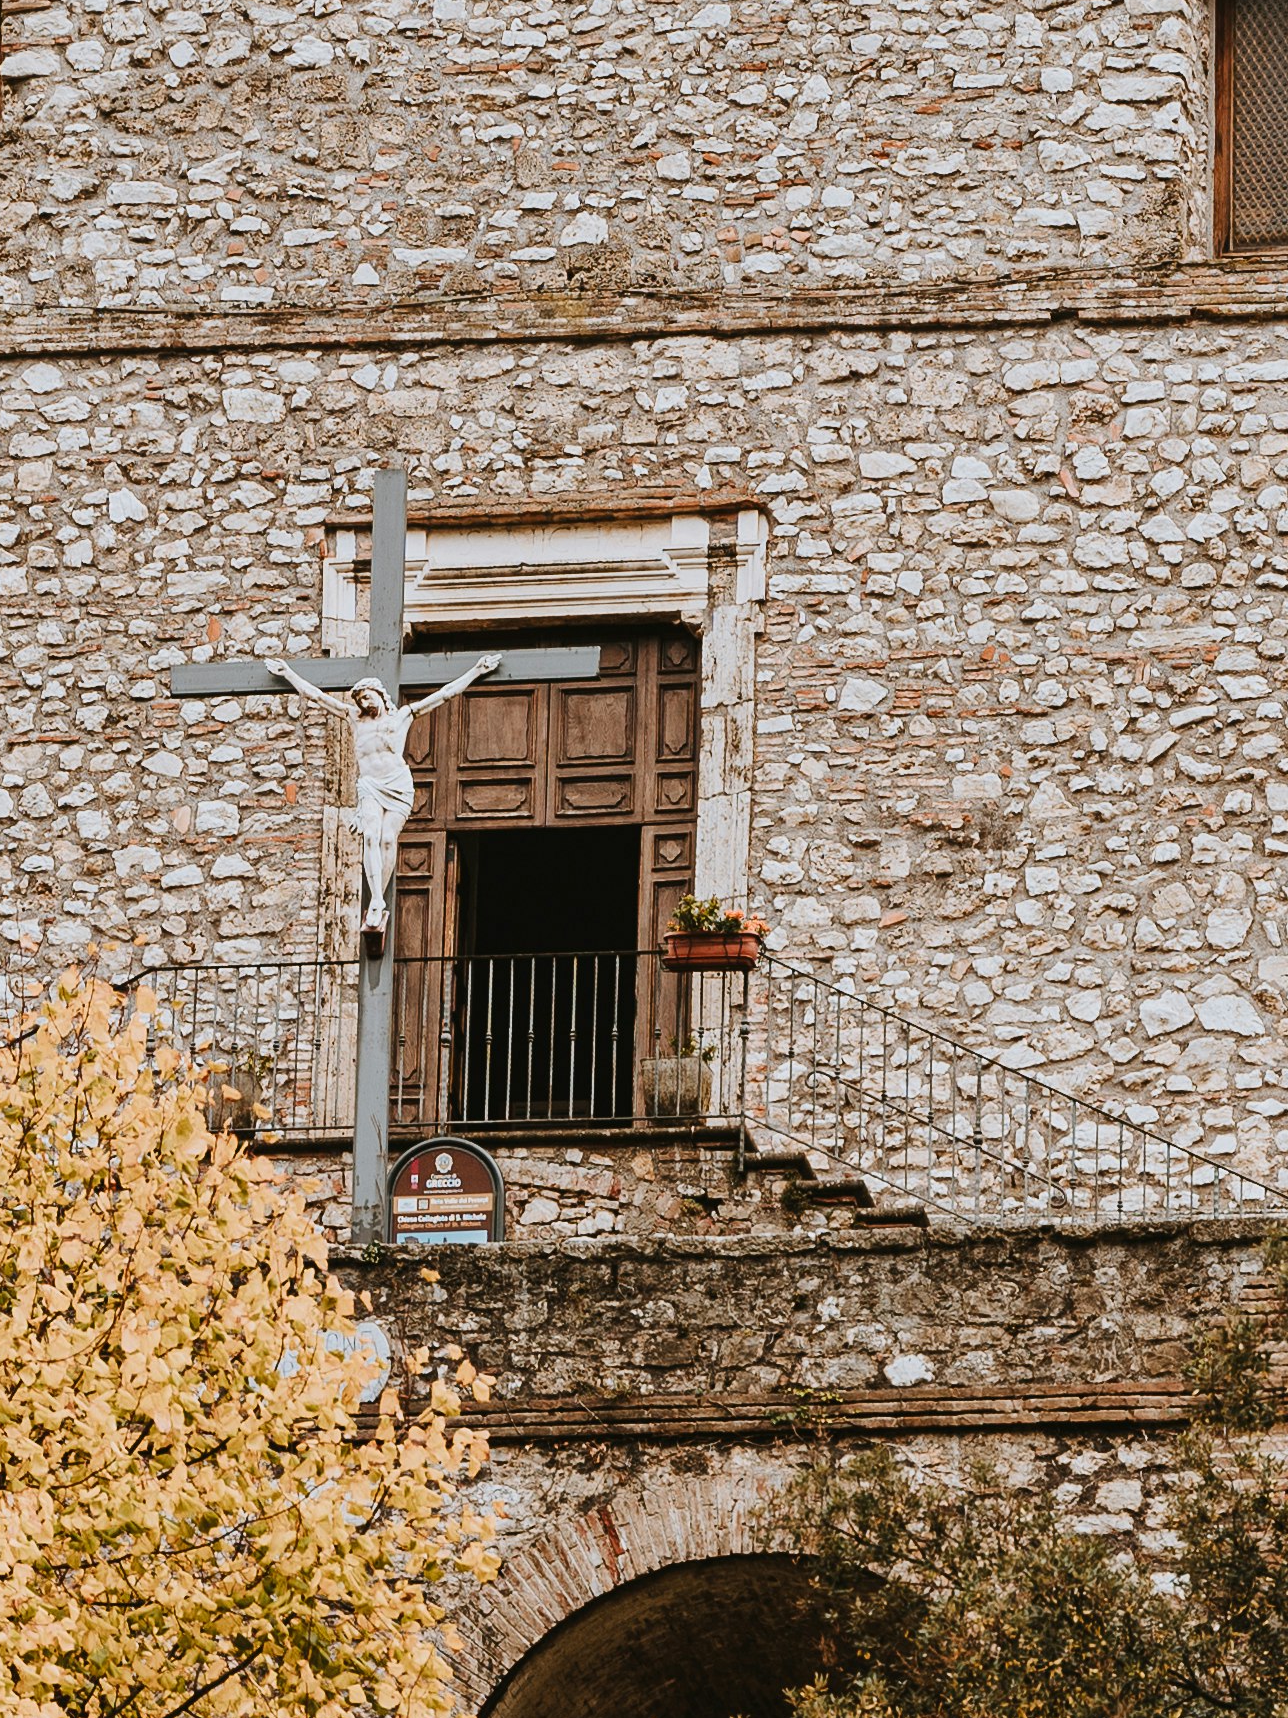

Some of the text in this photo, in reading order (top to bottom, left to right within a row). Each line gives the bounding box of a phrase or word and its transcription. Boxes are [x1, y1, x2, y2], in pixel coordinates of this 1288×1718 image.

[425, 1178, 461, 1188] GRECCIO
[397, 1215, 417, 1223] Chiesa
[418, 1214, 448, 1224] Collegiata
[463, 1213, 487, 1221] Michele
